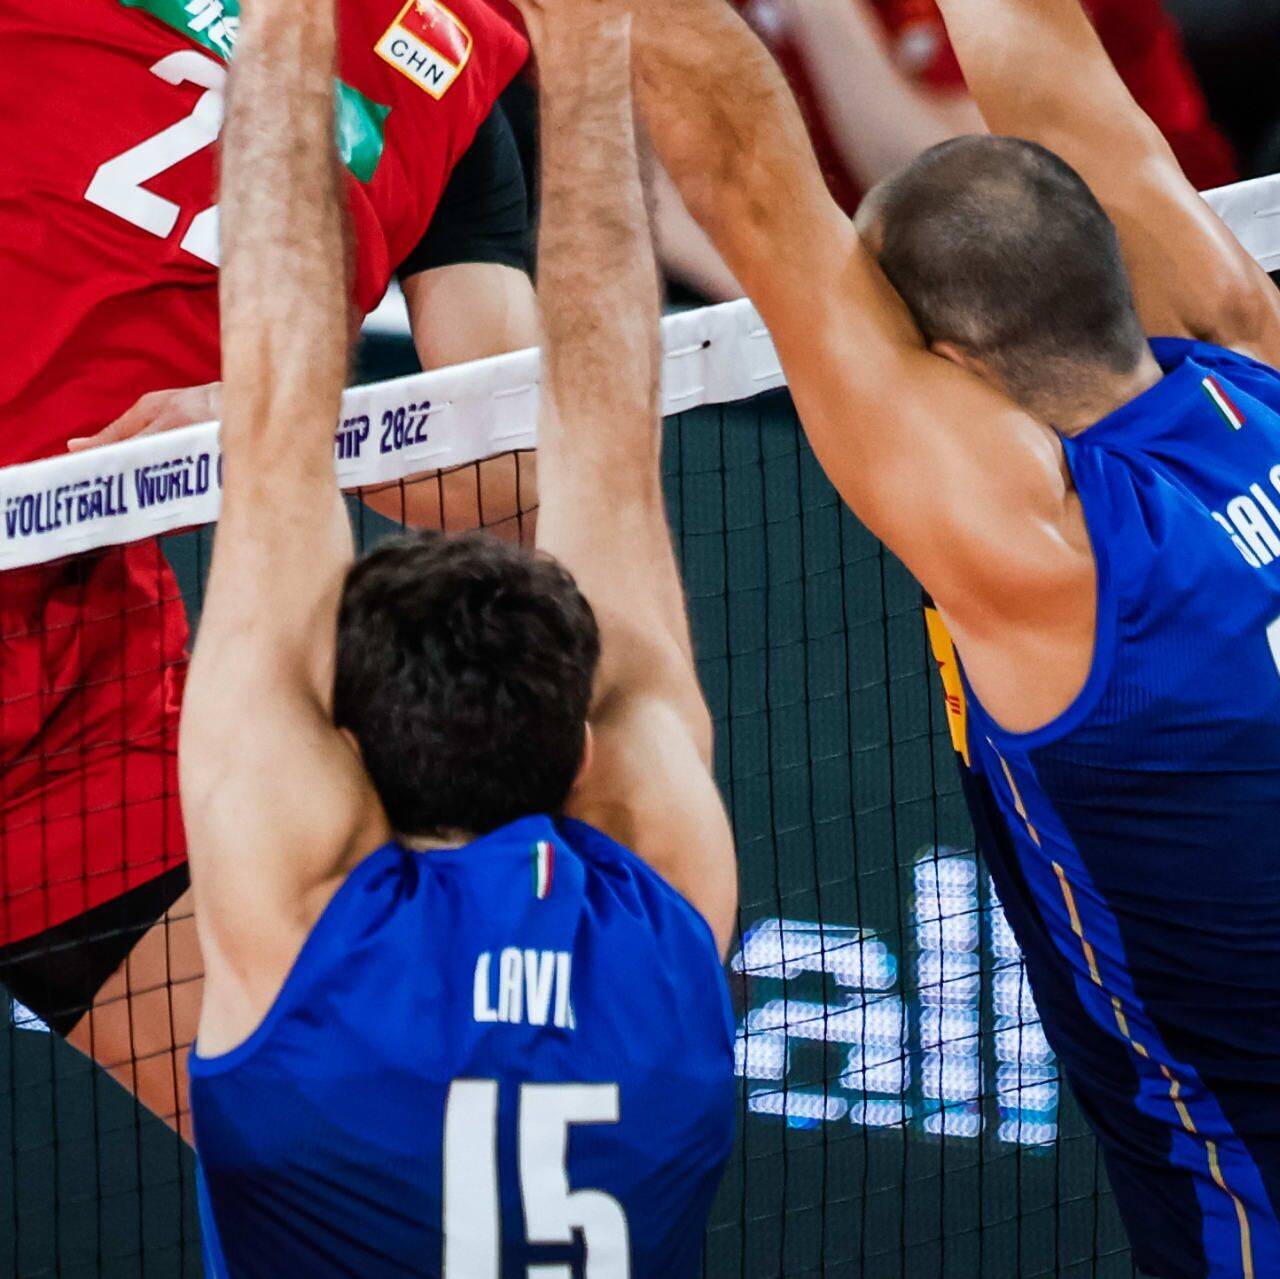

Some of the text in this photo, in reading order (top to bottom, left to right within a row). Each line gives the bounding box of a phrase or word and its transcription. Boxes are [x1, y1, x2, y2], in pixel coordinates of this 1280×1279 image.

[390, 38, 445, 86] CHN
[83, 49, 225, 268] 2
[4, 471, 128, 540] VOLLEYBALL
[134, 452, 211, 509] WORLD
[379, 400, 432, 455] 2022
[473, 946, 577, 1031] LAVI
[442, 1078, 632, 1279] 15
